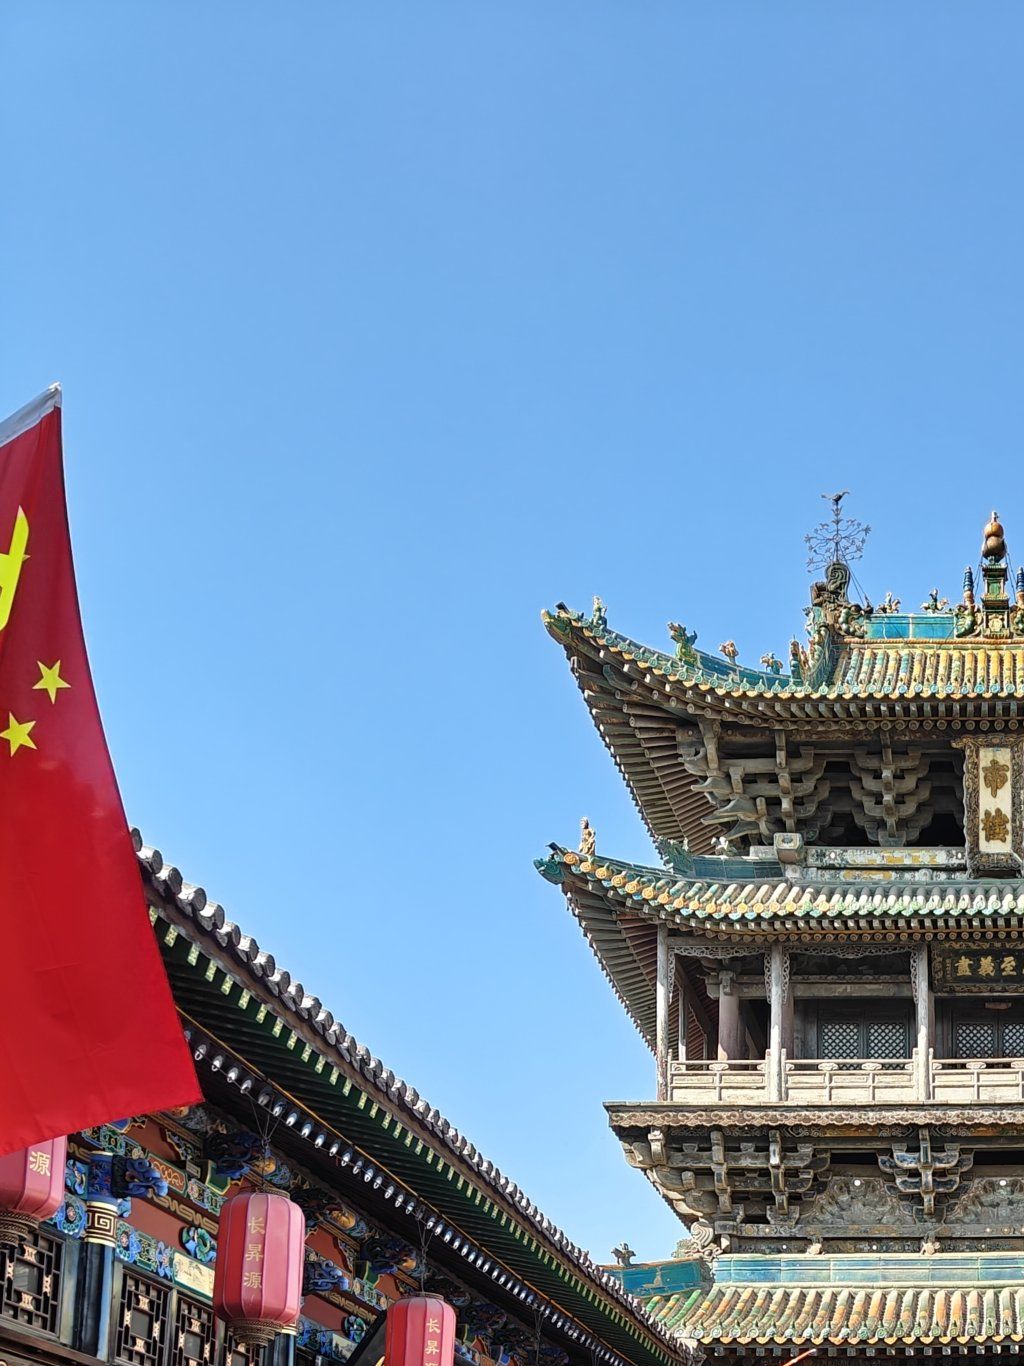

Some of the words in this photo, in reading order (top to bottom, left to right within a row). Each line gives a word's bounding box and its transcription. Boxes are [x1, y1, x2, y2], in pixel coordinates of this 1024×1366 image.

[29, 1150, 50, 1177] 源
[243, 1216, 265, 1289] 长昇源
